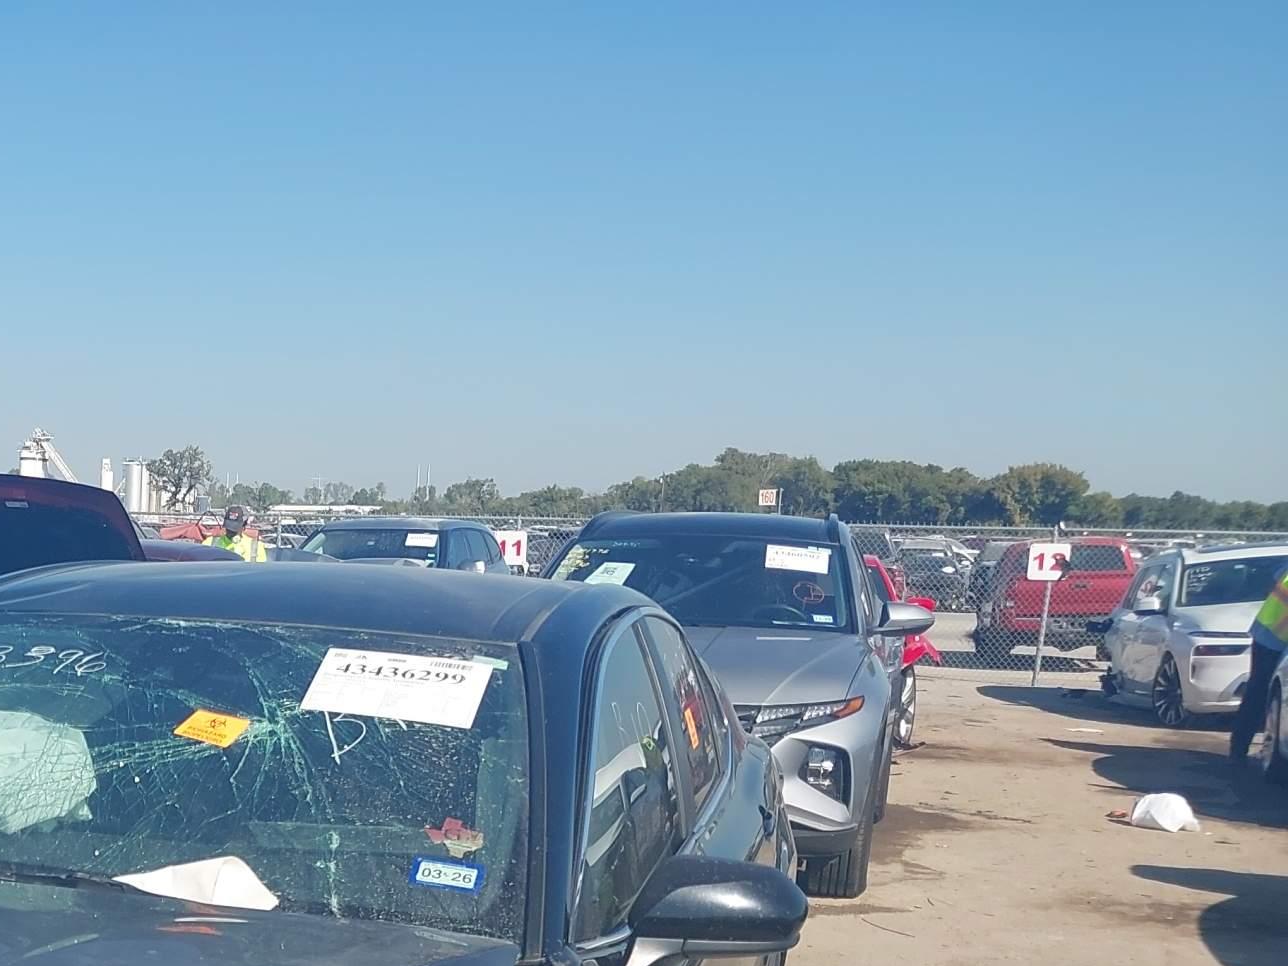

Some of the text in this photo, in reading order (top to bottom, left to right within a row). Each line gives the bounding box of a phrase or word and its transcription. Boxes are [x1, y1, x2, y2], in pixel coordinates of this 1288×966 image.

[760, 491, 775, 504] 160
[500, 540, 521, 557] 11
[336, 663, 466, 684] 43436299
